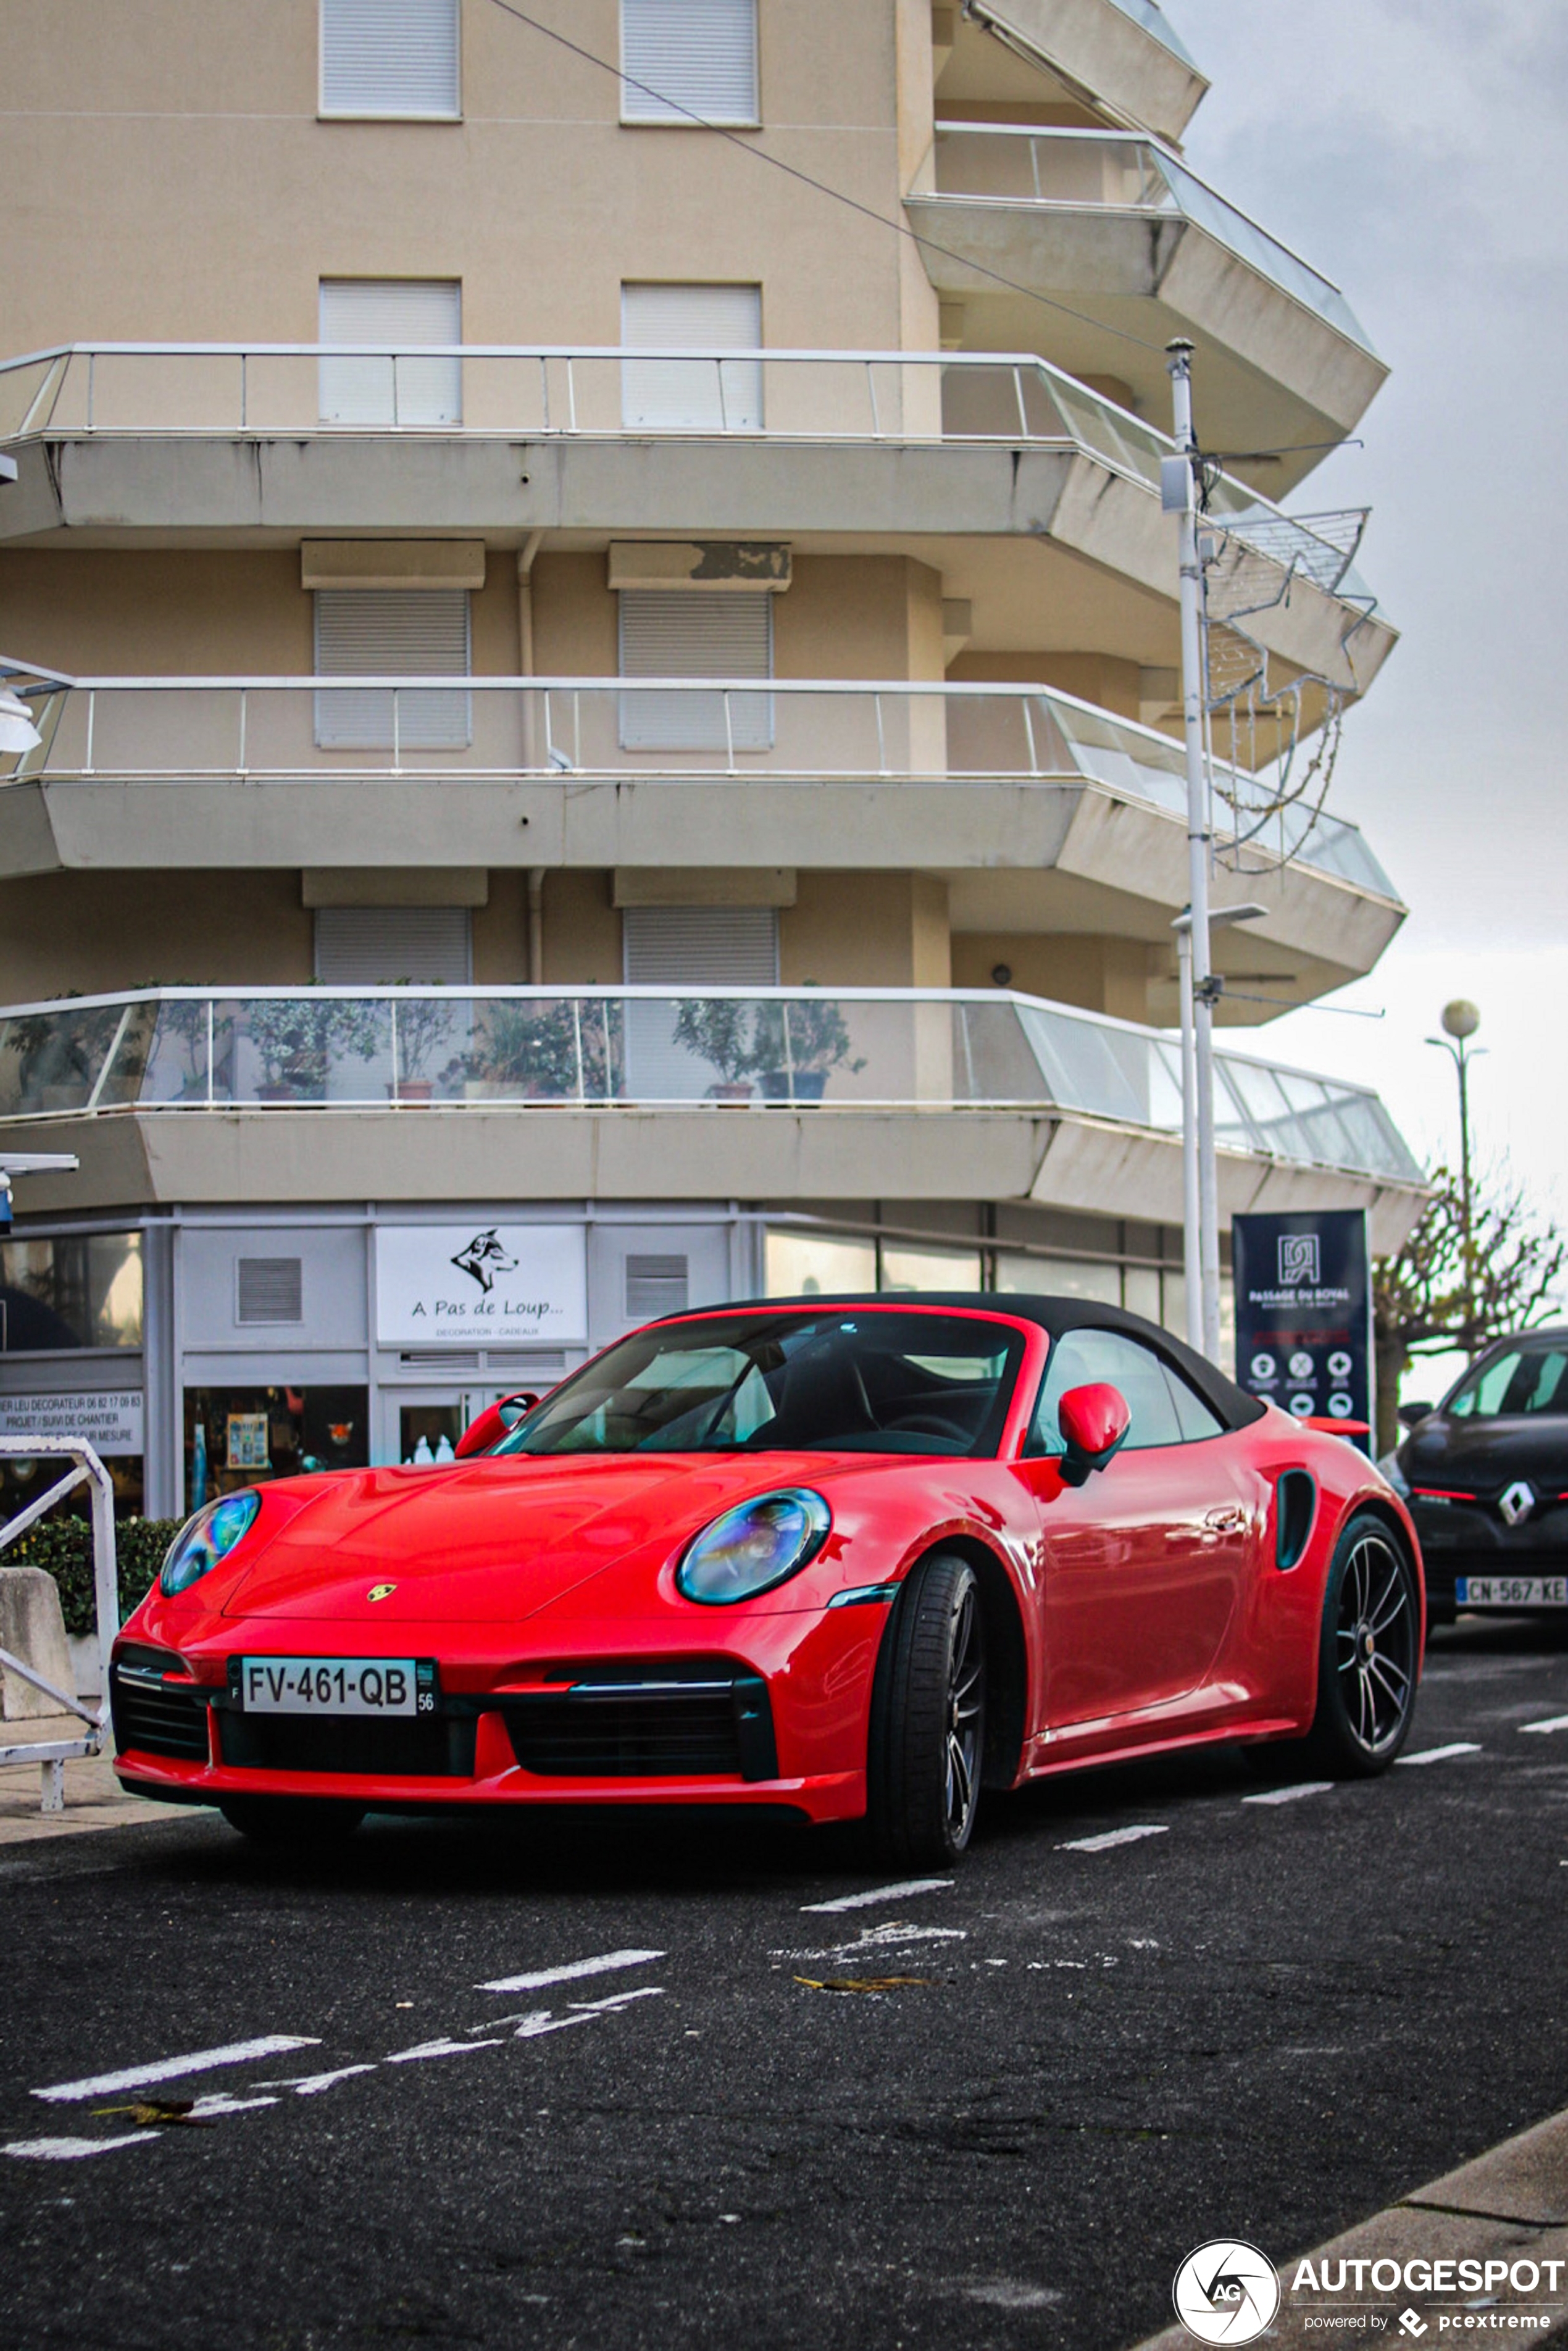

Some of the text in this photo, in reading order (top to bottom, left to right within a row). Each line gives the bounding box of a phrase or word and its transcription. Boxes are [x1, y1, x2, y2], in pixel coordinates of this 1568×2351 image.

[1249, 1288, 1350, 1301] PASSAGE DU ROYAL
[412, 1300, 564, 1319] A Pas de Loup...
[499, 1327, 539, 1336] CADEAUX
[31, 1397, 85, 1411] DECORATEUR
[110, 1396, 118, 1407] 17
[6, 1415, 36, 1427] PROJET
[43, 1414, 64, 1427] SUIVI
[65, 1414, 75, 1426] DE
[77, 1413, 119, 1426] CHANTIER
[98, 1429, 133, 1442] MESURE
[232, 1687, 238, 1698] F
[248, 1666, 406, 1708] FV-461-QB
[418, 1692, 434, 1711] 56
